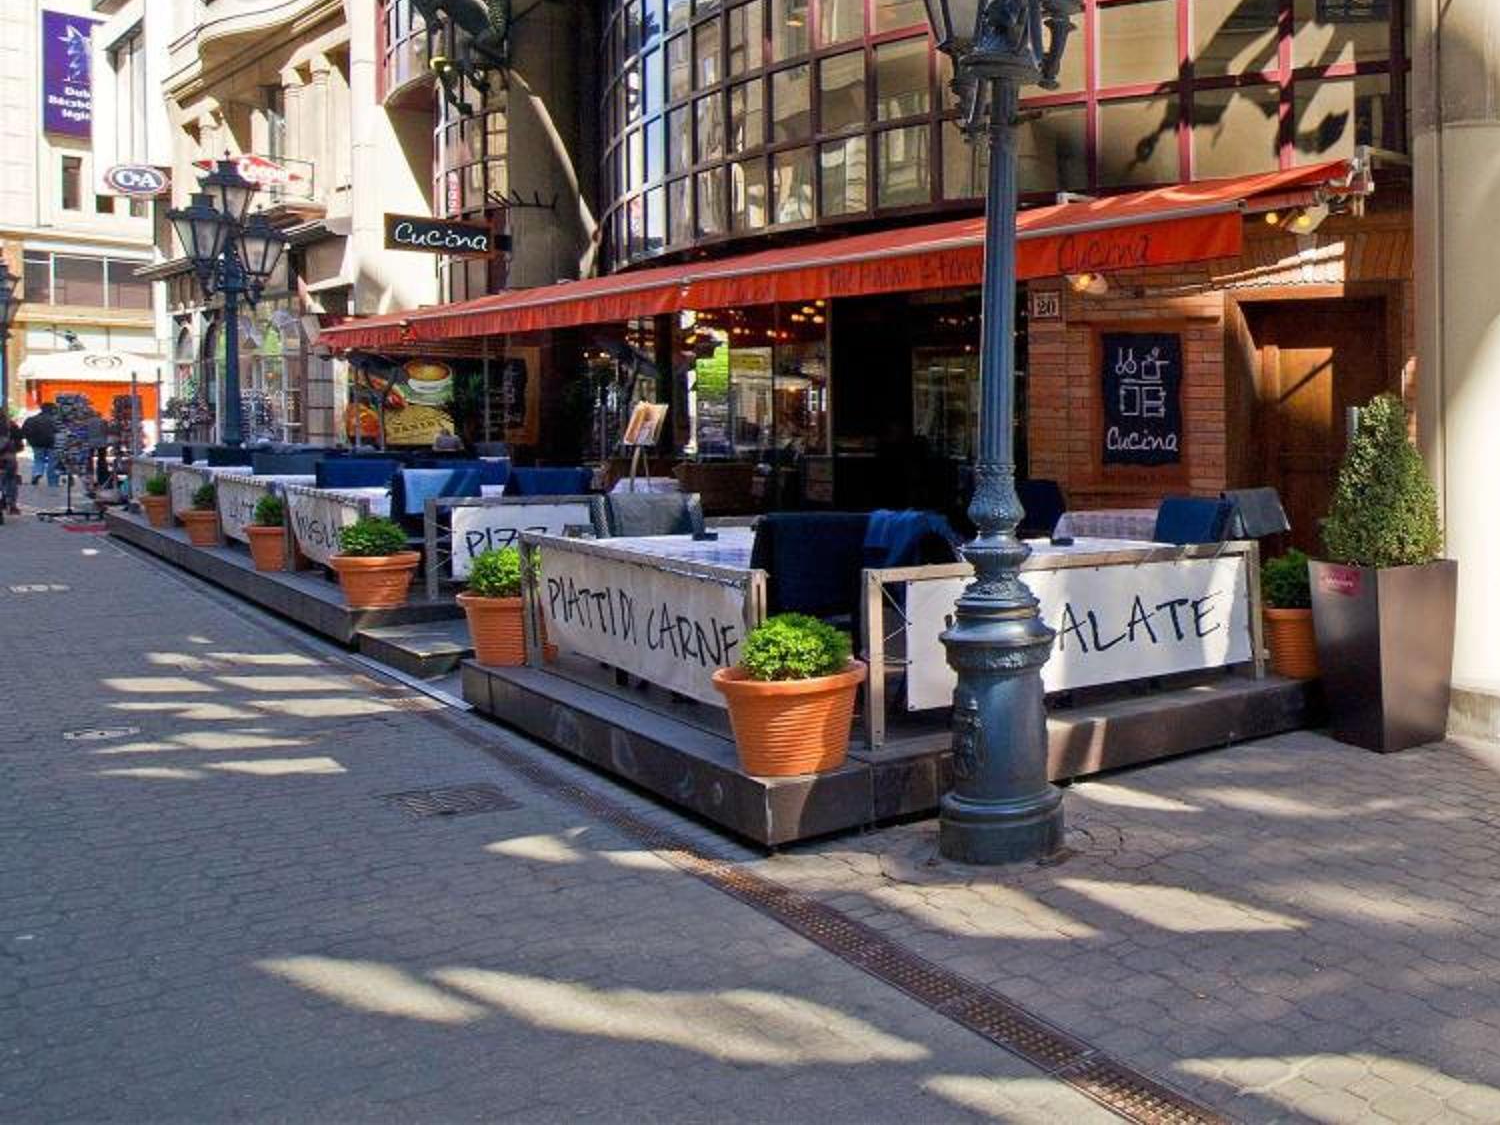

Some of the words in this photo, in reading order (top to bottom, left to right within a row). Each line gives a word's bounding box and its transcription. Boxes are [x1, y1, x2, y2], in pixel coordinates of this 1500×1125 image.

[394, 222, 488, 252] Cucina
[1106, 426, 1179, 452] Cucina
[547, 575, 617, 636] PIATTI
[619, 587, 637, 646] DI
[1057, 589, 1224, 653] ALATE
